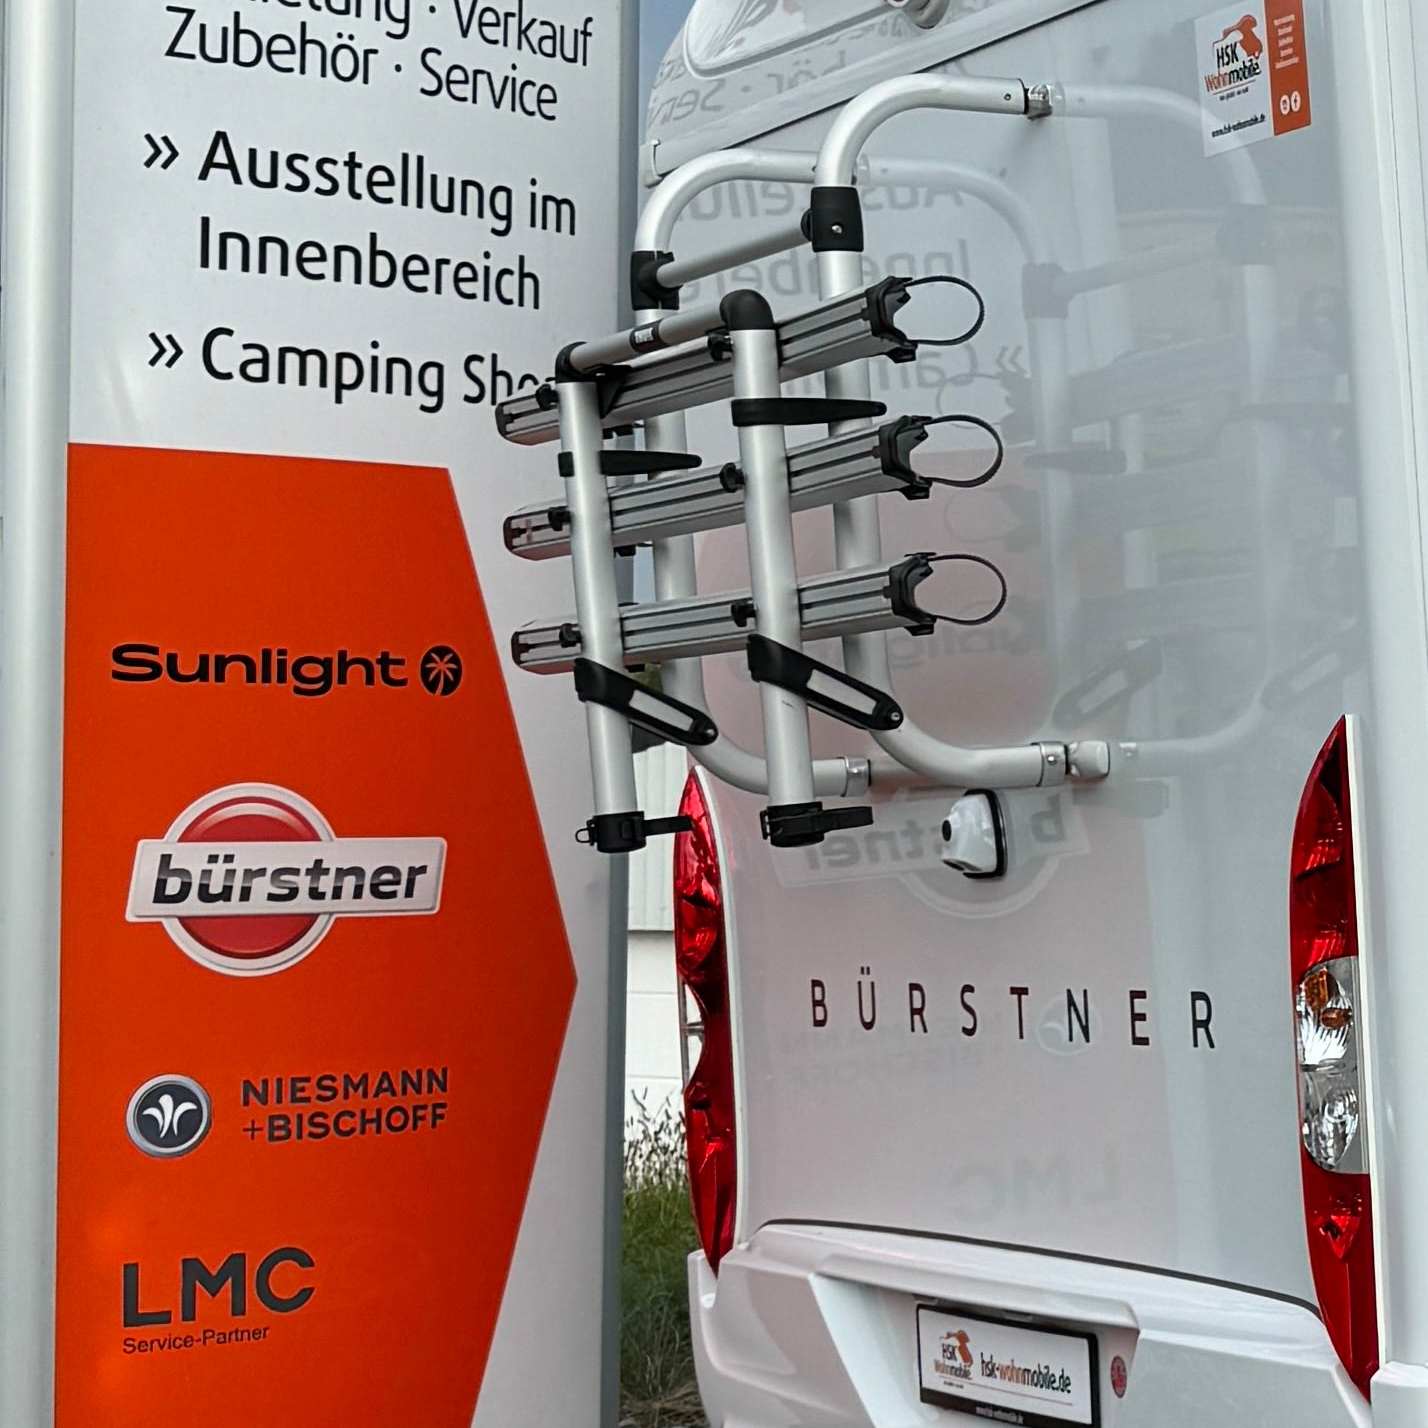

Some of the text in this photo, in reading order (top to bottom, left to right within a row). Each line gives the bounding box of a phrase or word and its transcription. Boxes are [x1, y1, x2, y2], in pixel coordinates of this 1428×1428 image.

[165, 5, 379, 85] Zubehör
[419, 48, 558, 121] Service
[1216, 41, 1239, 69] HSK
[198, 130, 576, 236] Ausstellung im
[200, 216, 540, 310] Innenbereich
[202, 327, 444, 414] Camping
[111, 643, 409, 697] Sunlight
[152, 854, 428, 905] bürstner
[810, 966, 1216, 1049] BÜRSTNER
[242, 1067, 449, 1107] NIESMANN
[122, 1247, 316, 1328] LMC
[122, 1325, 270, 1354] Service-Partner
[980, 1352, 1072, 1394] hsk-wohnmobile.de
